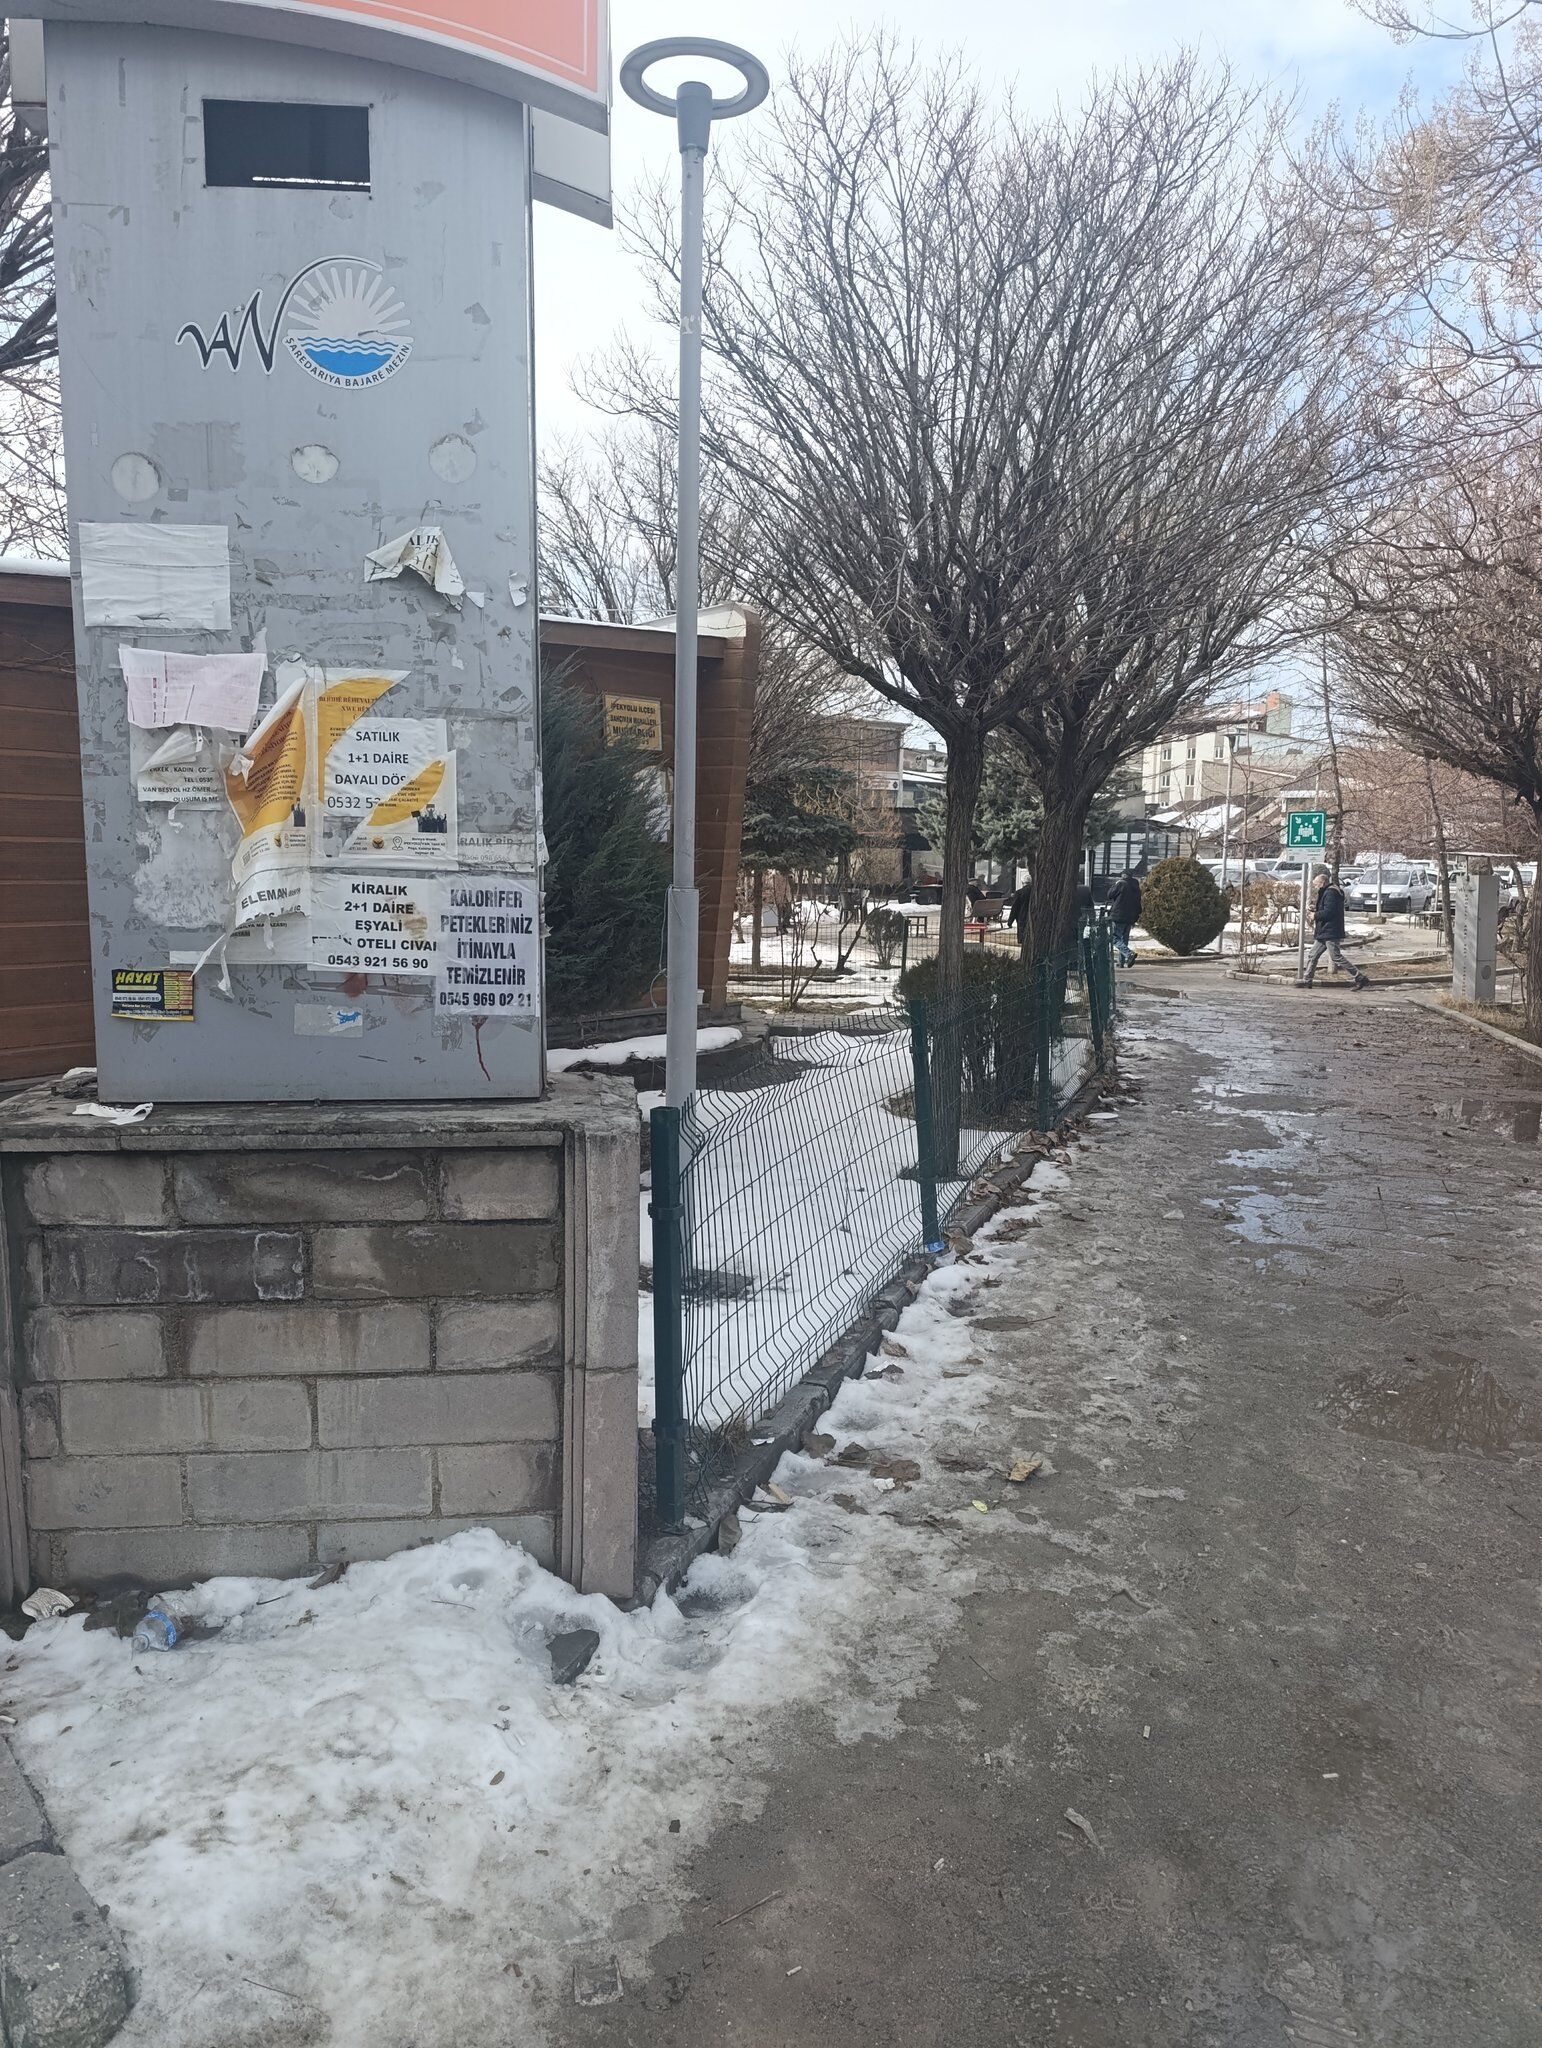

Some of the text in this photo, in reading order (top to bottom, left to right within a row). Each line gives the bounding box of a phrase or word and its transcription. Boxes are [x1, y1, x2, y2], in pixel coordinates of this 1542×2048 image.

[355, 731, 400, 742] SATILIK
[348, 751, 409, 764] 1+1 DAİRE
[335, 774, 378, 785] DAYALI
[327, 796, 361, 809] 0532
[351, 881, 408, 896] KİRALIK
[241, 887, 288, 910] ELEMAN
[450, 887, 523, 908] KALORİFER
[344, 901, 414, 914] 2+1 DAİRE
[355, 920, 403, 933] EŞYALİ
[440, 913, 533, 934] PETEKLERİNİZ
[457, 938, 516, 960] İTİNAYLA
[328, 955, 428, 969] 0543 921 56 90
[115, 971, 161, 984] HAYAT
[446, 964, 526, 986] TEMİZLENİR
[439, 992, 532, 1008] 0545 969 02 21
